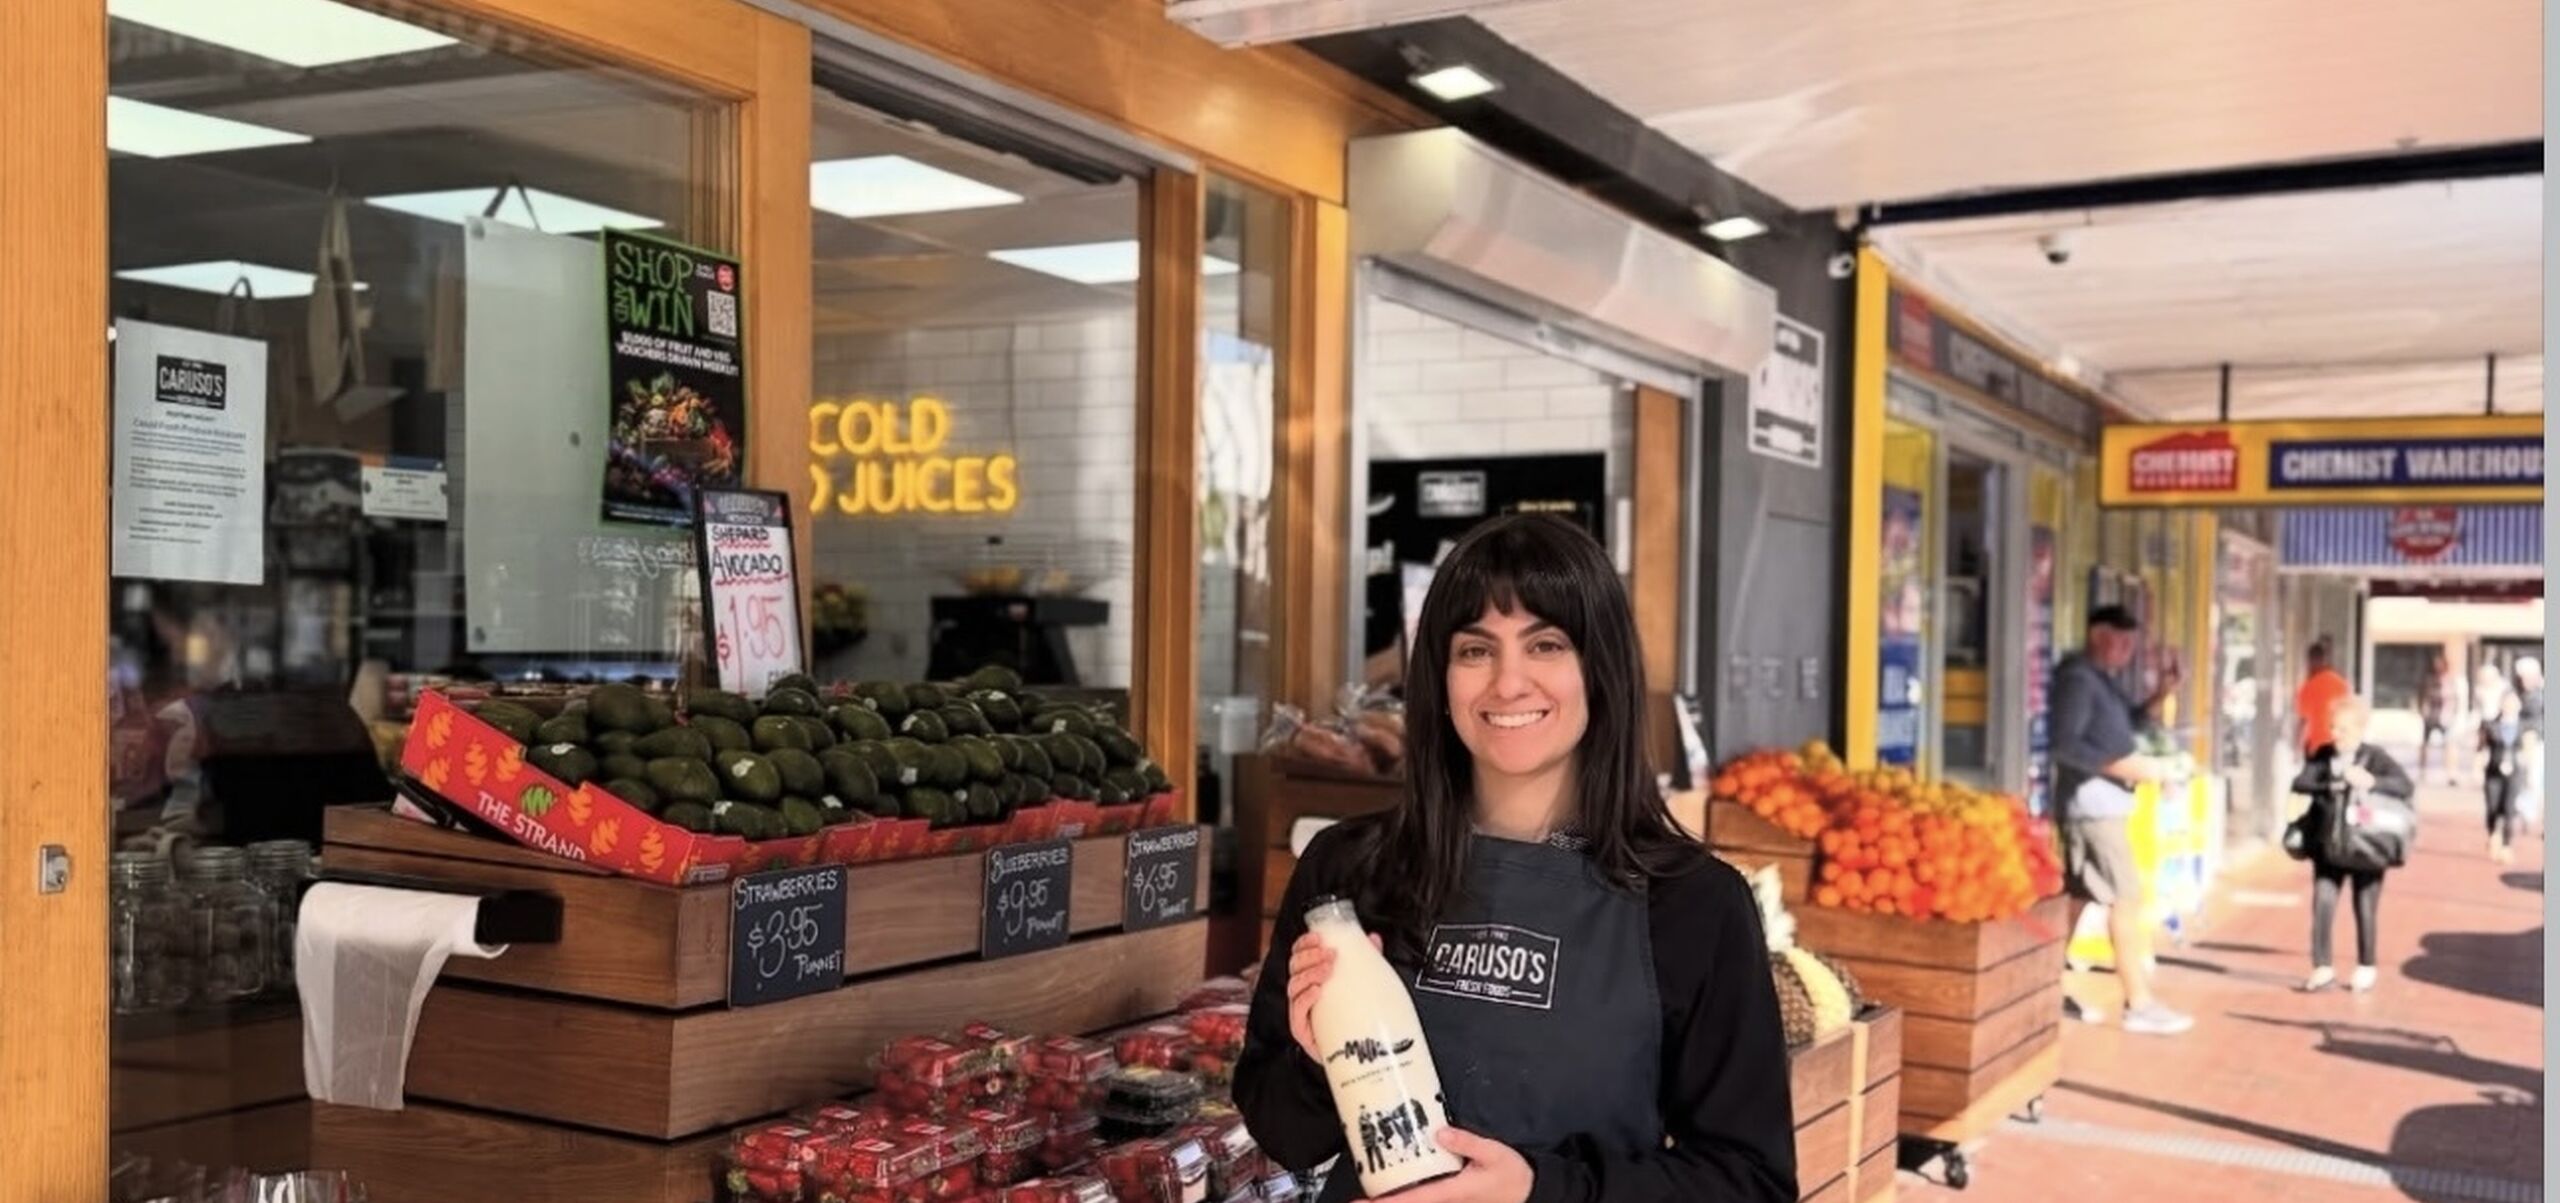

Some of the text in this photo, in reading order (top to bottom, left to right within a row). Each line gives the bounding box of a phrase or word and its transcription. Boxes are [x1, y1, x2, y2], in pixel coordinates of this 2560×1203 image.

[615, 241, 693, 293] SHOP
[614, 280, 628, 322] AND
[628, 286, 693, 336] WIN
[615, 342, 667, 361] VOUCHERS
[667, 353, 702, 370] DRAWN
[653, 338, 667, 349] OF
[668, 340, 693, 354] FRUIT
[694, 347, 713, 360] AND
[159, 366, 224, 397] CARUSO'S
[809, 397, 950, 456] COLD
[2281, 446, 2544, 481] CHEMIST WAREHOU
[838, 454, 1017, 514] JUICES
[711, 525, 769, 542] SHEPARD
[711, 547, 783, 578] AVOCADO
[477, 790, 511, 826] THE
[1129, 830, 1198, 859] STRAWBERRIES
[990, 847, 1069, 884] BLUEBERRIES
[735, 869, 839, 910] STRAWBERRIES
[1433, 942, 1547, 985] CARUSO'S
[1454, 979, 1482, 993] FRESH
